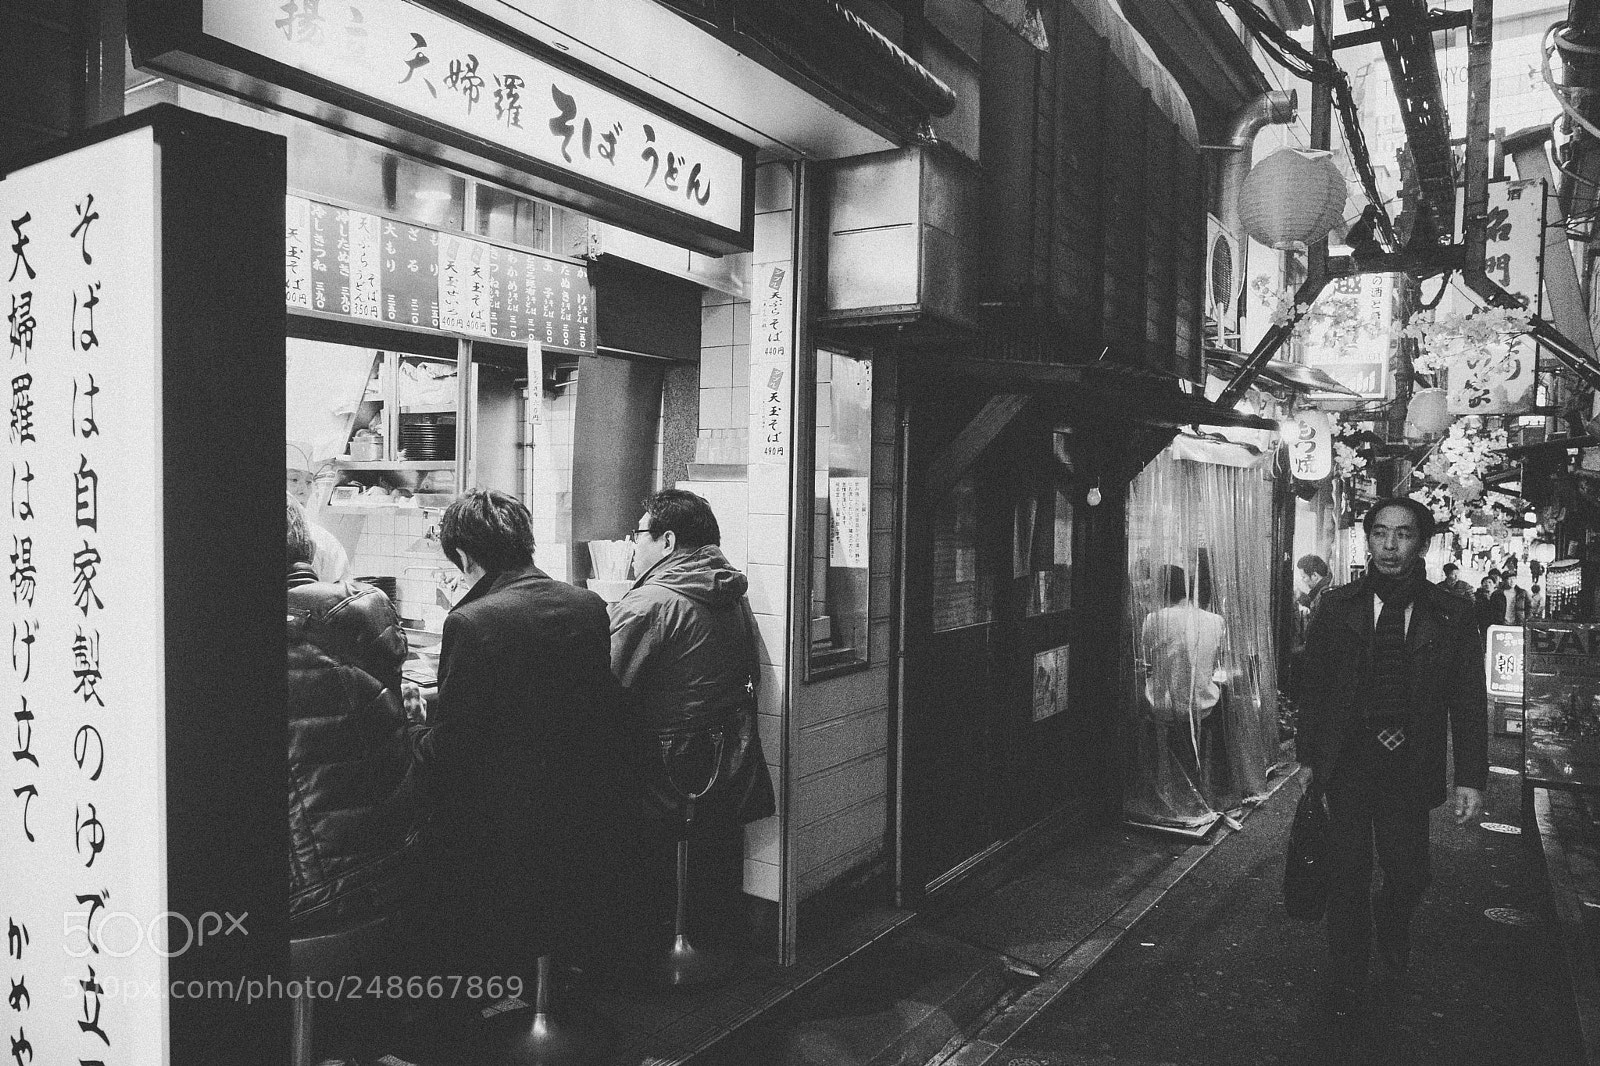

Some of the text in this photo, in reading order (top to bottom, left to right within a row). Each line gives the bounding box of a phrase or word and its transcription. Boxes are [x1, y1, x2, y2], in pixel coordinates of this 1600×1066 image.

[398, 32, 525, 130] 天婦羅
[549, 83, 624, 166] そば
[641, 124, 711, 206] うどん
[384, 222, 398, 273] 大もり
[471, 266, 485, 320] 天玉そば
[561, 264, 571, 302] たぬき
[577, 267, 588, 305] かけ
[768, 292, 783, 343] 天ぷらそば
[764, 346, 785, 356] 440円
[767, 391, 782, 443] 天玉そば
[8, 211, 39, 843] 天婦羅は揚げ立て
[70, 193, 110, 1066] そばは自家製のゆで立
